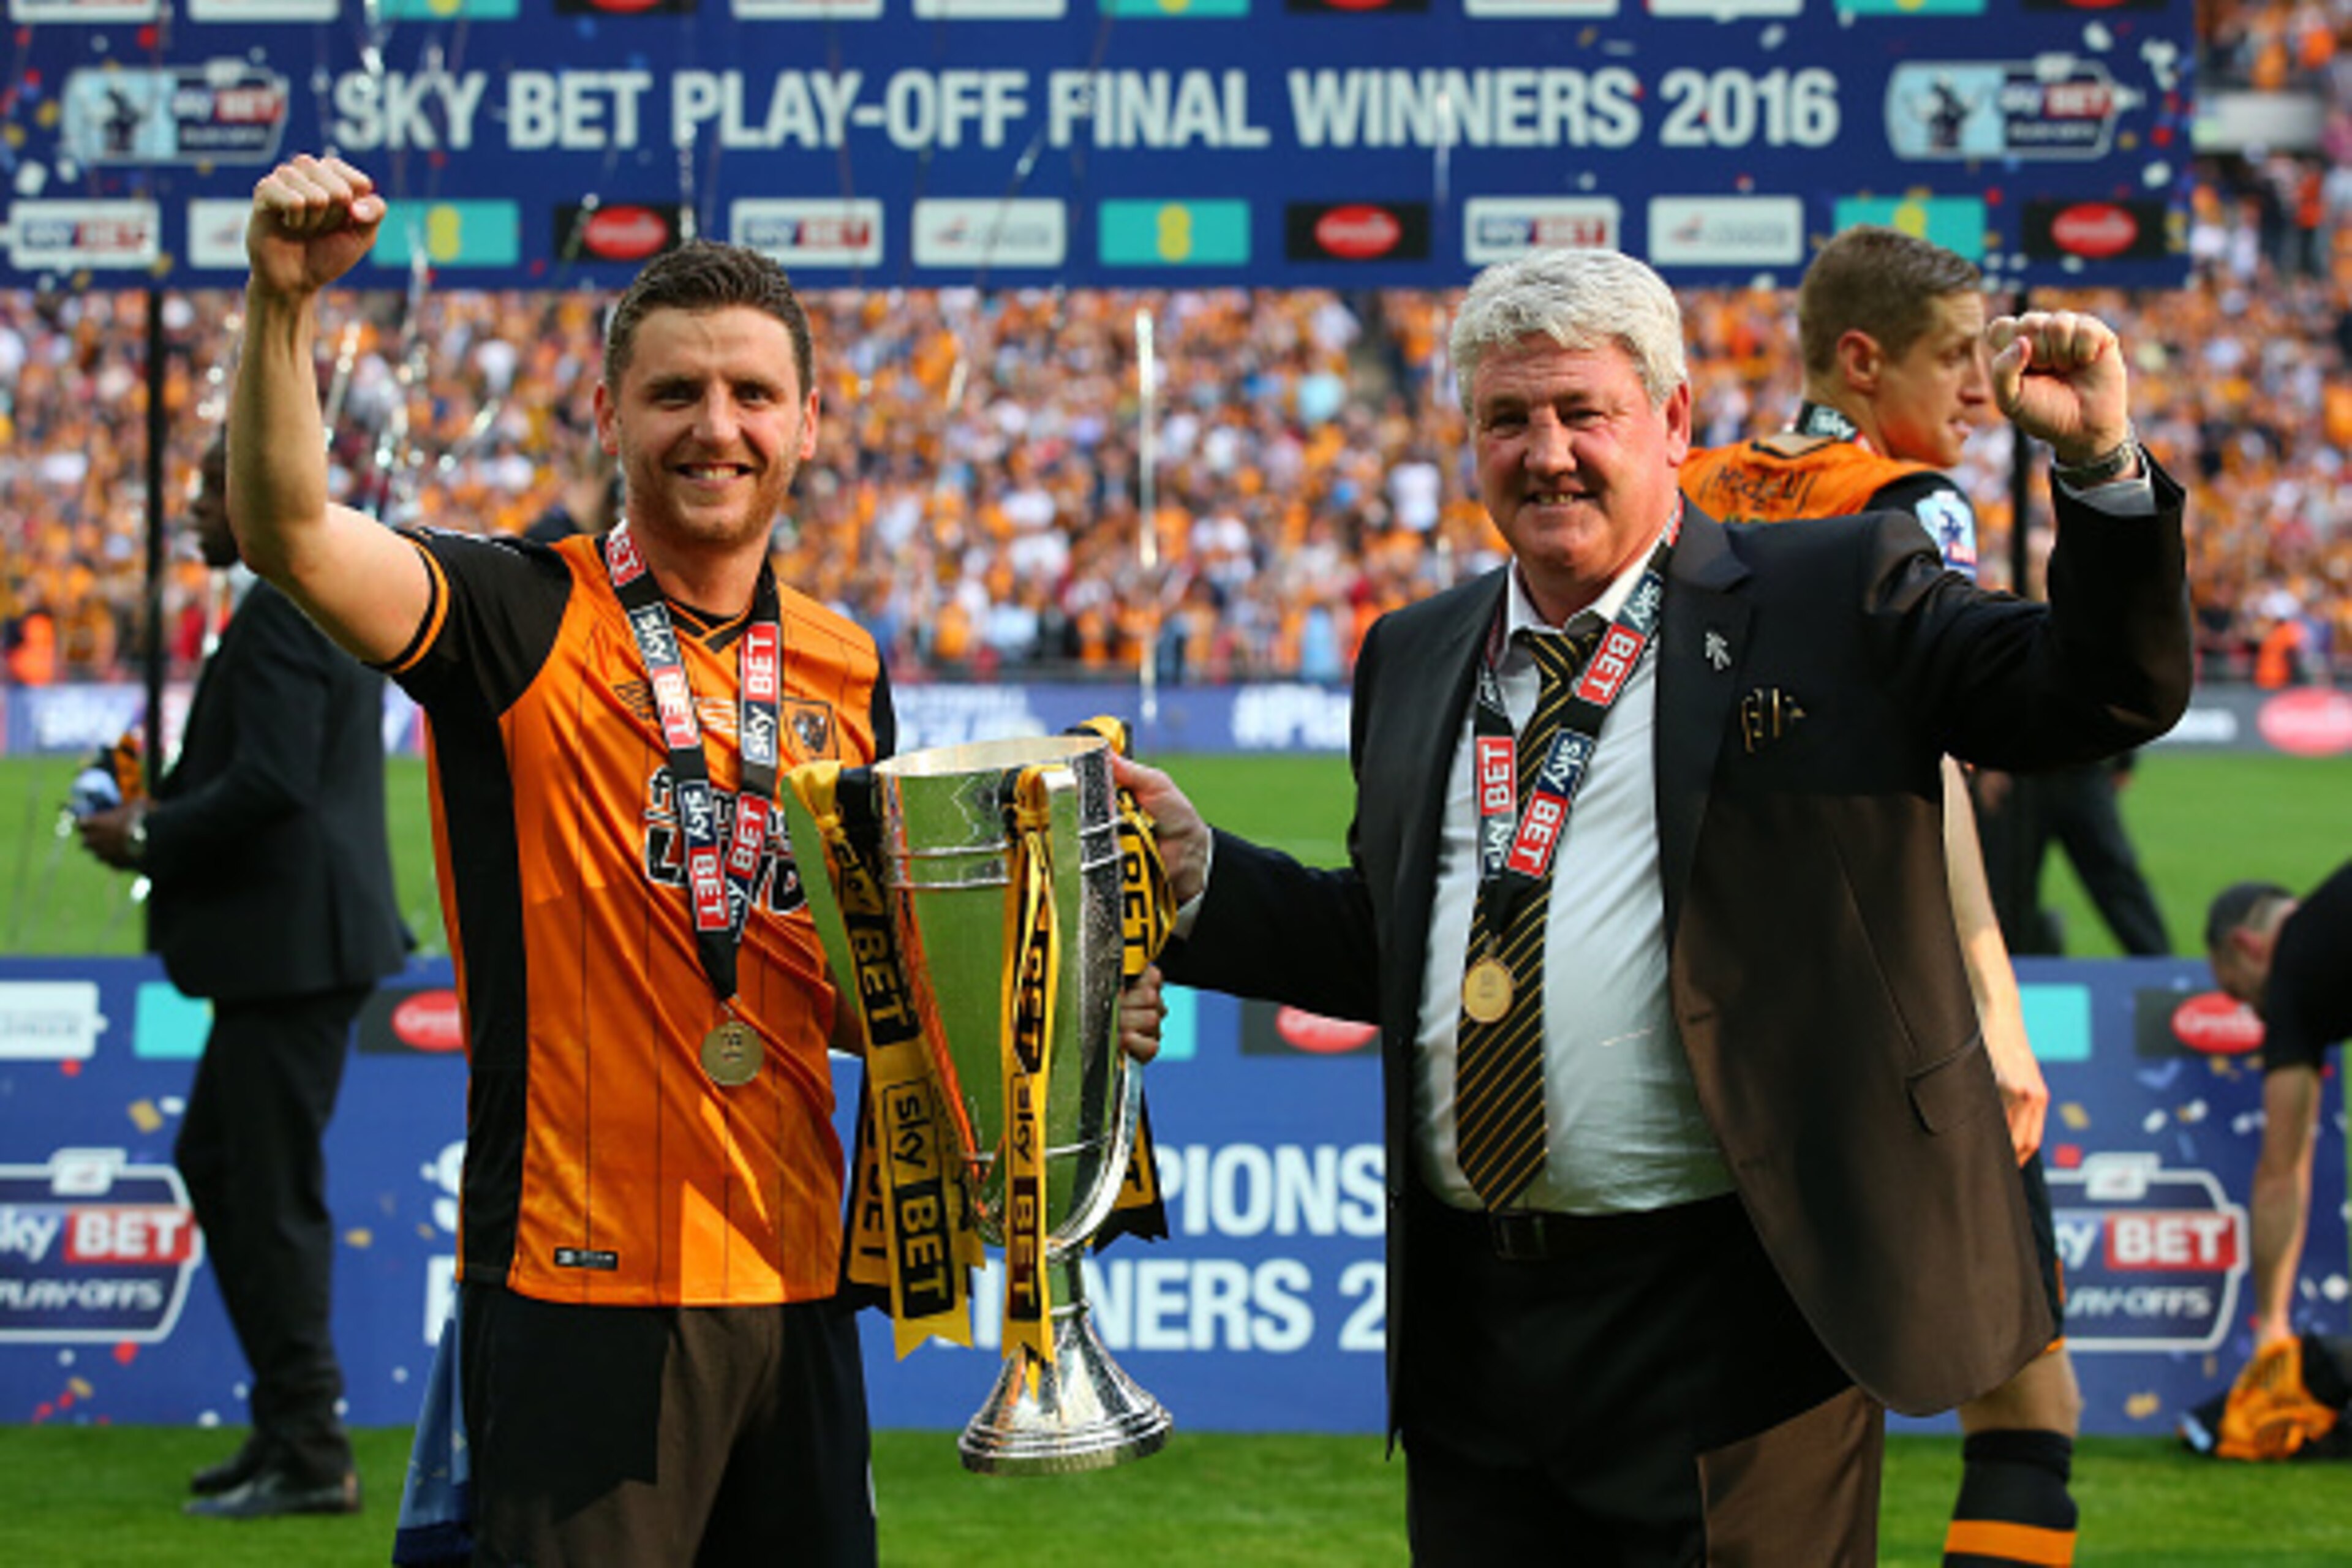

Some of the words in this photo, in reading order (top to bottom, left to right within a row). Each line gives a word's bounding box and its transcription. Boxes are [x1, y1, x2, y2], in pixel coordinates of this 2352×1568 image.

[335, 69, 487, 149] SKY
[508, 70, 652, 149] BET
[671, 69, 1029, 149] PLAY-OFF
[1049, 69, 1271, 149] FINAL
[1287, 67, 1643, 149] WINNERS
[1659, 67, 1839, 148] 2016
[1626, 577, 1664, 630] sky
[636, 614, 670, 662] sky
[655, 673, 696, 741] BET
[748, 633, 774, 696] BET
[1591, 632, 1637, 702] BET
[742, 703, 776, 758] sky
[1482, 744, 1510, 809] BET
[1544, 737, 1582, 793] sky
[684, 790, 712, 842] sky
[731, 802, 763, 872] BET
[1520, 798, 1561, 874] BET
[692, 854, 727, 920] BET
[850, 928, 908, 1027] BET
[892, 1093, 927, 1170] sky
[75, 1210, 186, 1258] BET
[900, 1194, 948, 1302] BET
[1014, 1194, 1036, 1308] BET
[2114, 1216, 2230, 1264] BET
